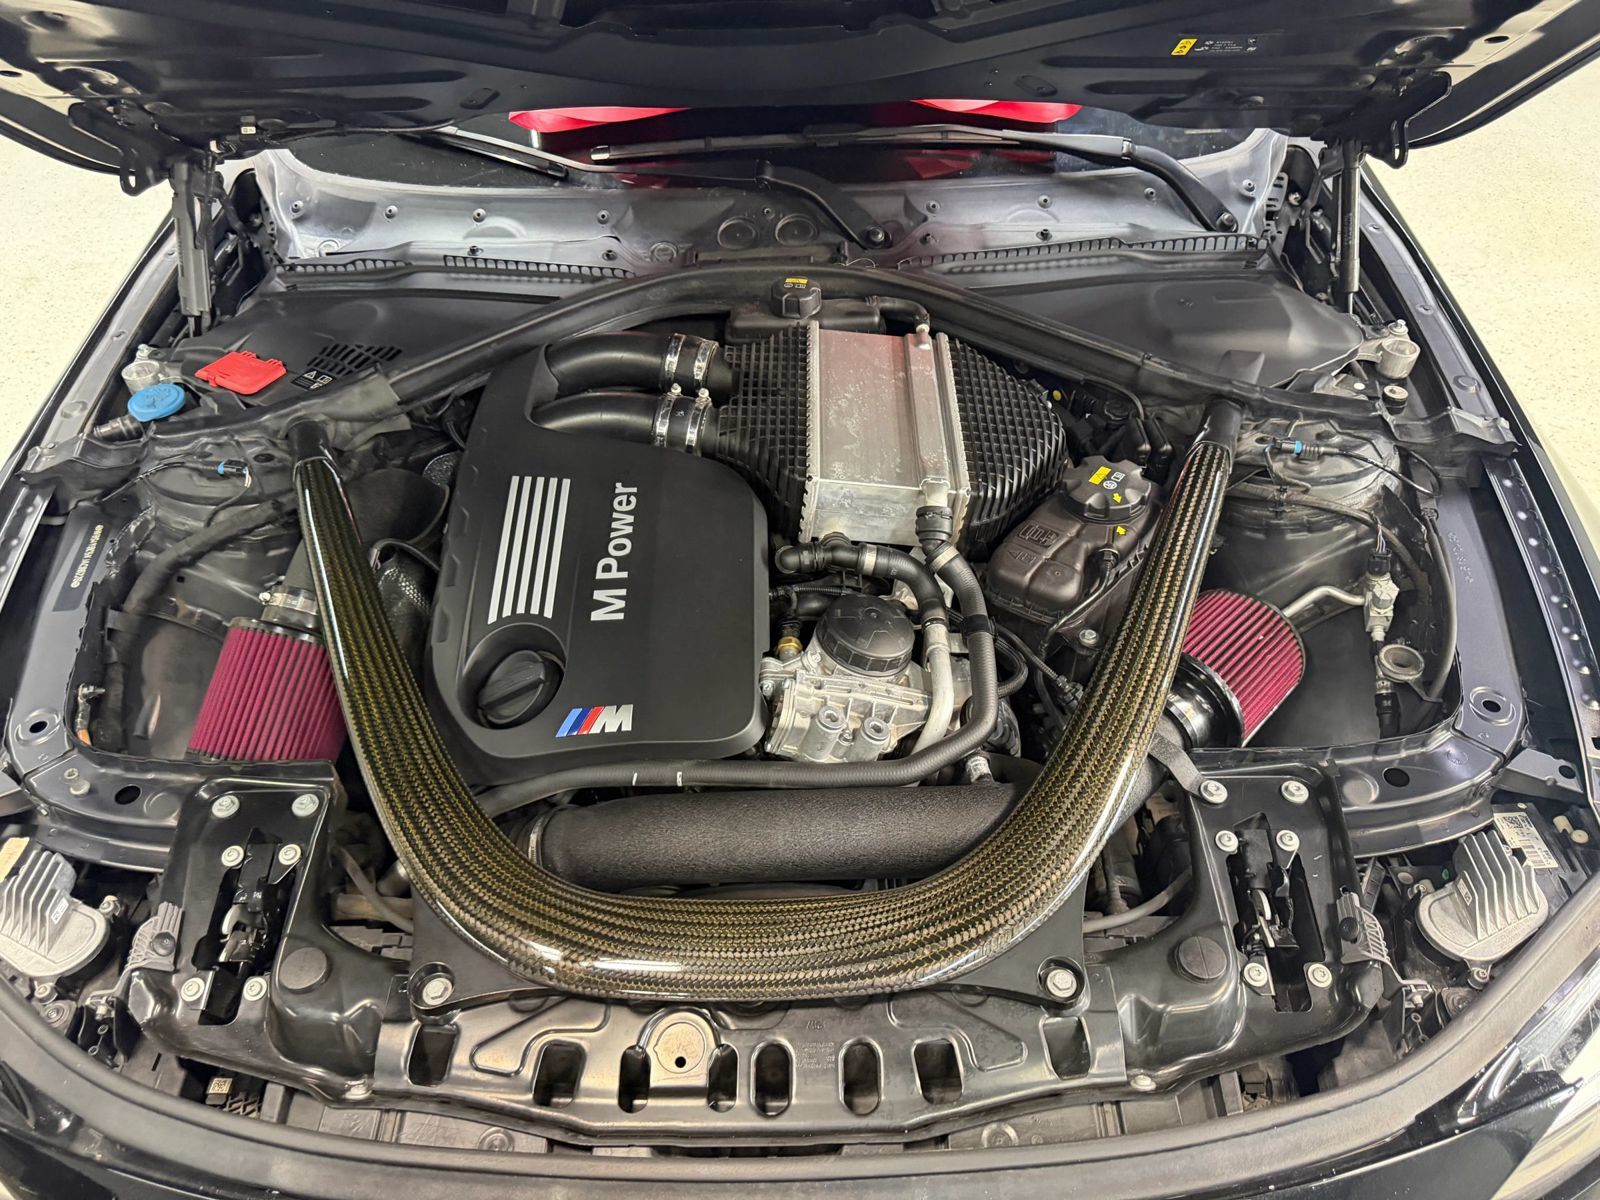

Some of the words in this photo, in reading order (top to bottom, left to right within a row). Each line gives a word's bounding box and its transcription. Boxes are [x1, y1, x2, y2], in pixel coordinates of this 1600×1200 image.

[595, 482, 638, 579] Power
[590, 588, 627, 621] M
[587, 704, 634, 734] M
